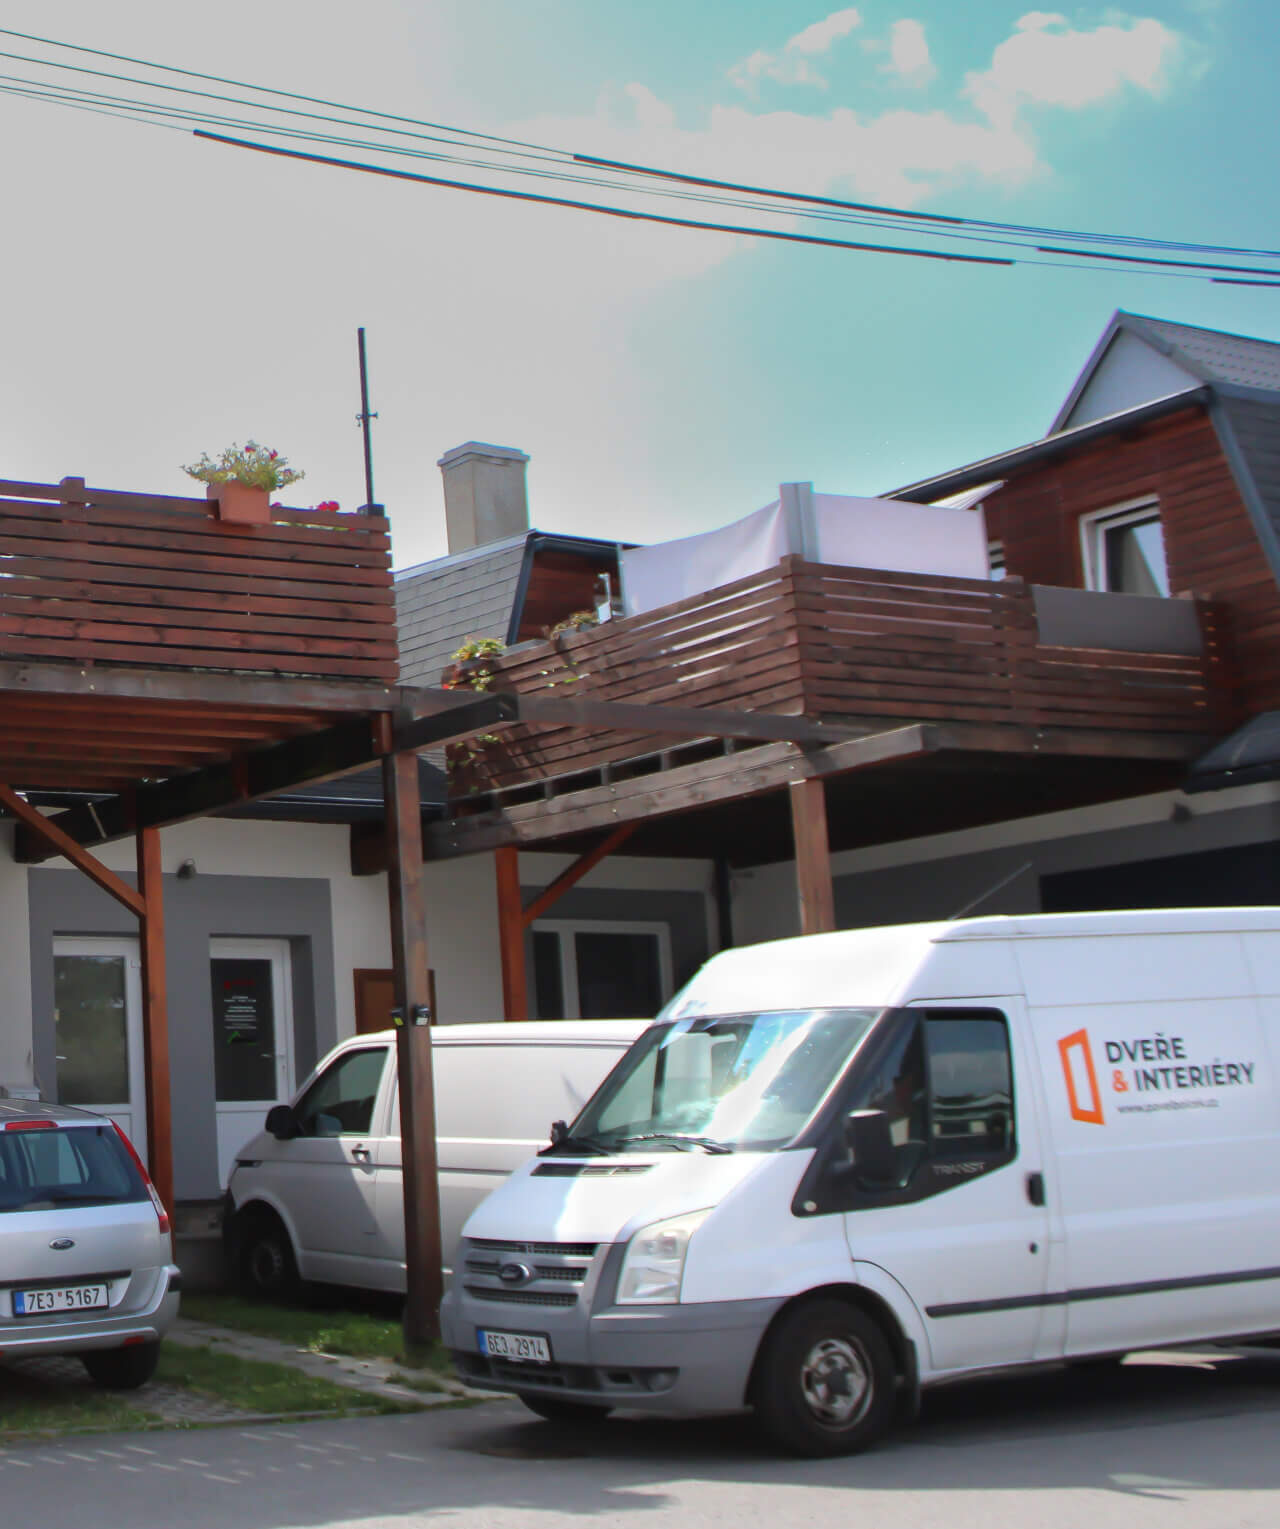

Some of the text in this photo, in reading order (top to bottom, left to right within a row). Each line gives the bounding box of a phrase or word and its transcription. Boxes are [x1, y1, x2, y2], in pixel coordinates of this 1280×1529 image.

[1105, 1032, 1187, 1063] DVEŘE
[1112, 1058, 1255, 1093] & INTERIÉRY
[28, 1286, 100, 1311] 7E3 5167
[488, 1334, 543, 1356] 6E3 2914
